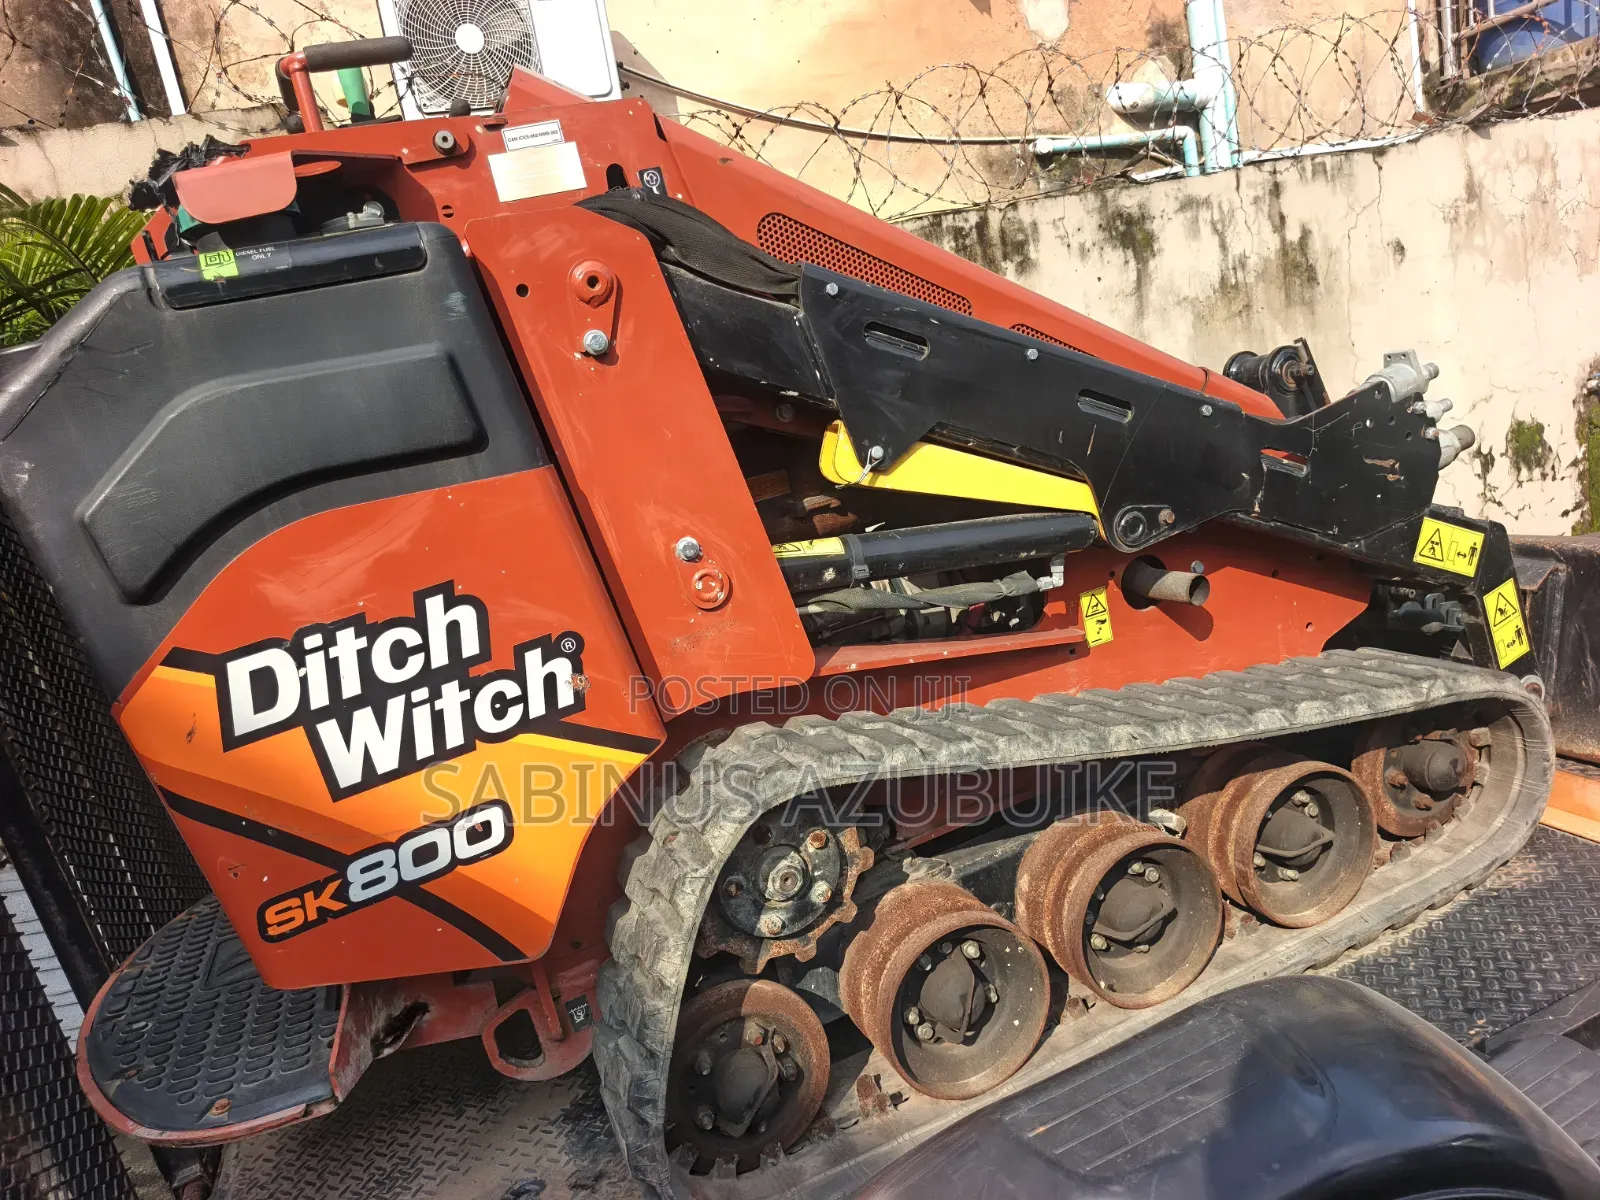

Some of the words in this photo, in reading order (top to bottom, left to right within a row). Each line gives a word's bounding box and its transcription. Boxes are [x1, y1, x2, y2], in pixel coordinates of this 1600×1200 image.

[235, 249, 259, 257] DIESEL
[251, 252, 272, 260] ONLY
[225, 593, 480, 737] Ditch
